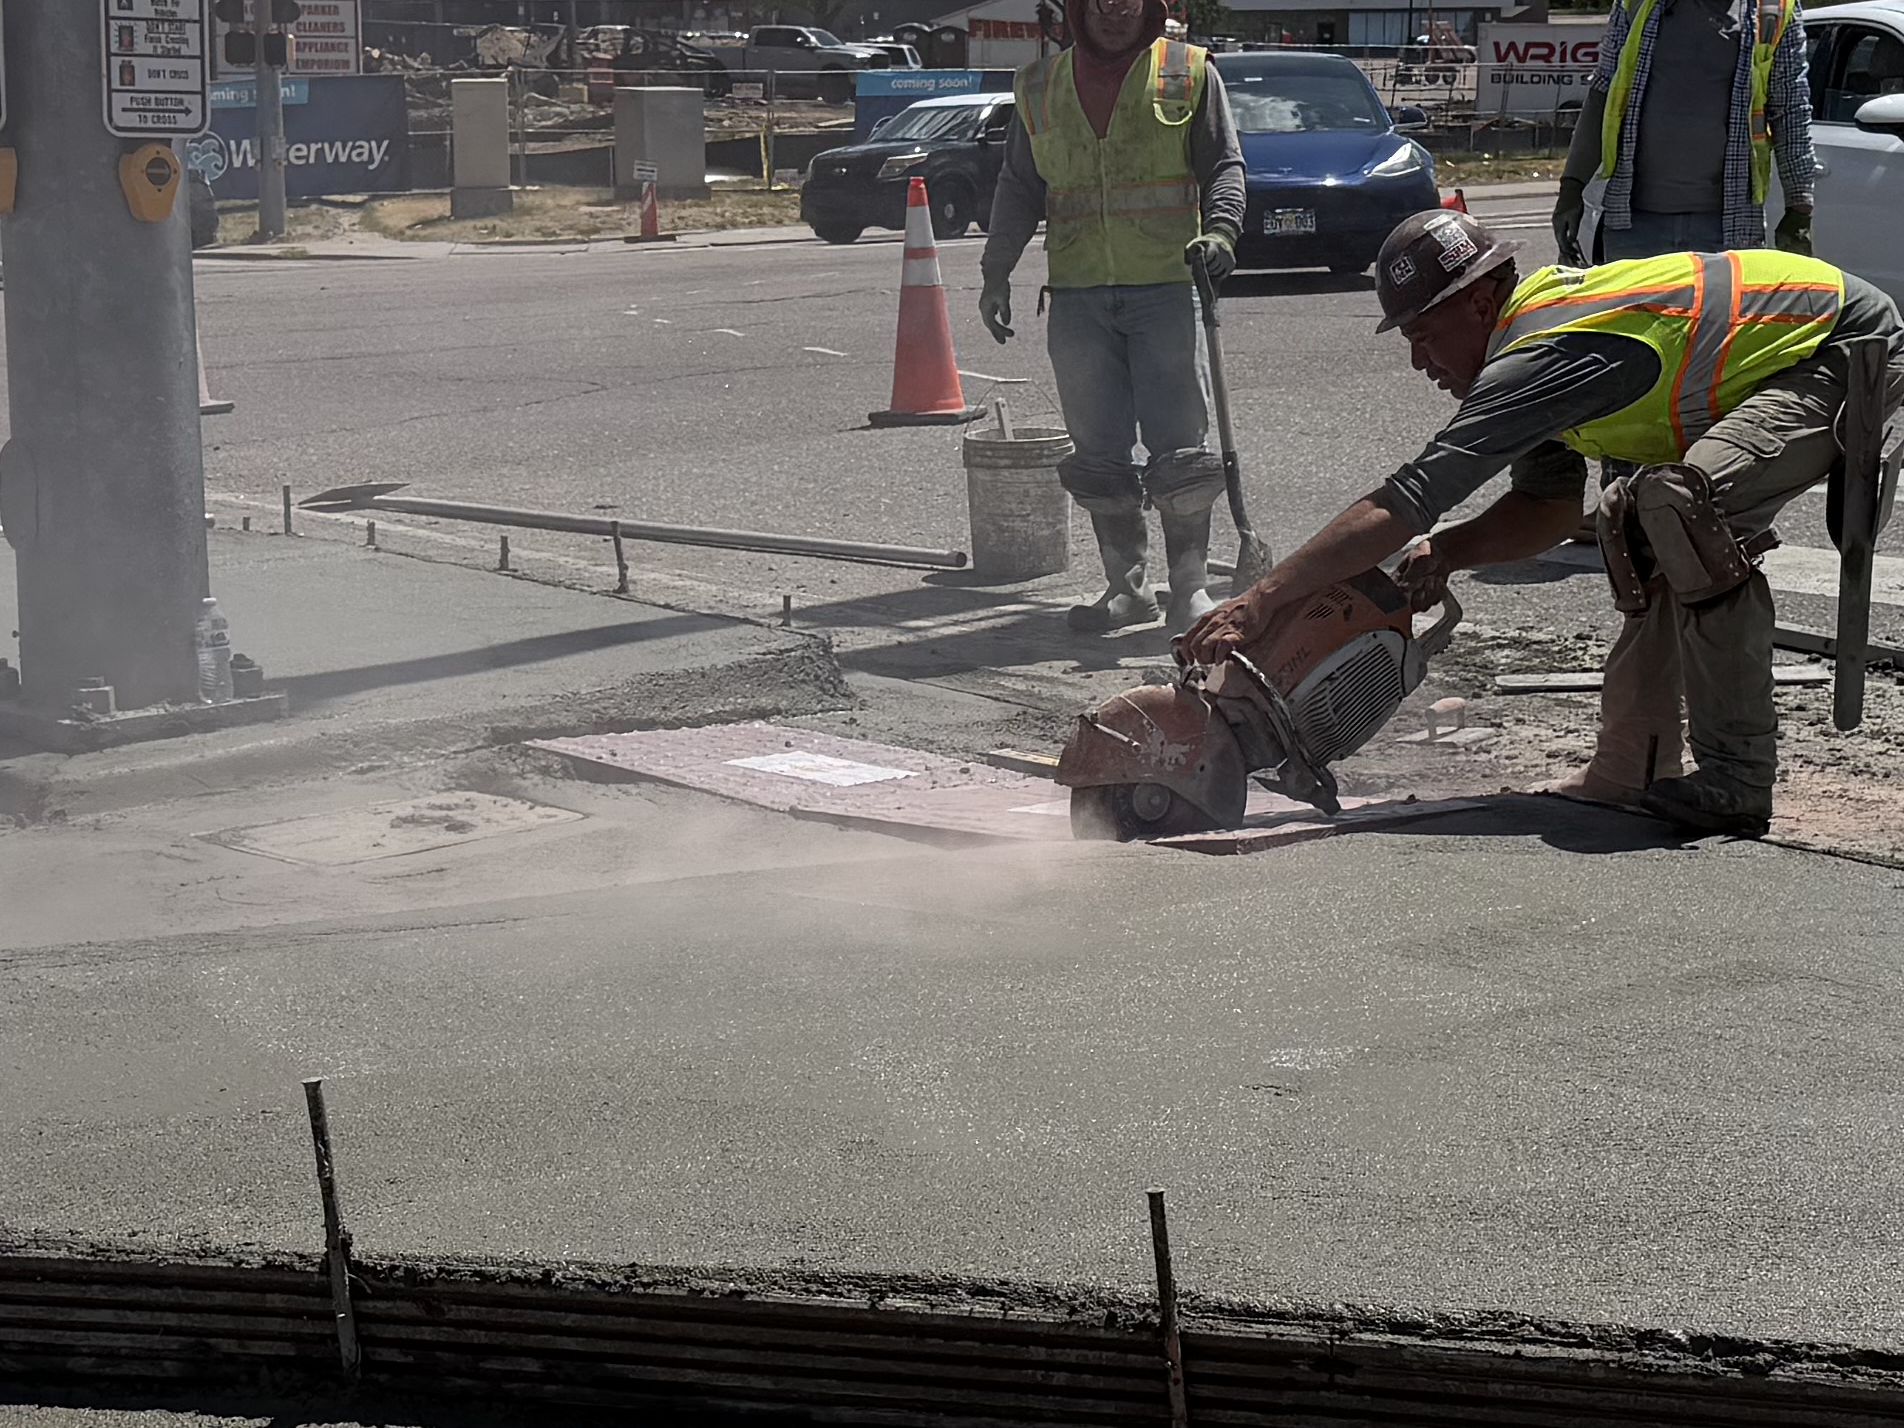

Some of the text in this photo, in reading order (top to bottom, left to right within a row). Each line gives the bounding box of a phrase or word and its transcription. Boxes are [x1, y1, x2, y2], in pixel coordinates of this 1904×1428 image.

[300, 4, 340, 16] PARKER
[296, 21, 346, 33] CLEANERS
[296, 41, 349, 53] APPLIANCE
[1493, 41, 1600, 64] WRIG
[296, 58, 351, 71] EMPORIUM
[891, 75, 973, 91] coming soon!
[1490, 73, 1573, 86] BUILDING
[129, 95, 185, 107] PUSH BUTTON
[210, 88, 250, 105] ming
[137, 114, 178, 125] TO CROSS
[229, 139, 390, 171] Werway
